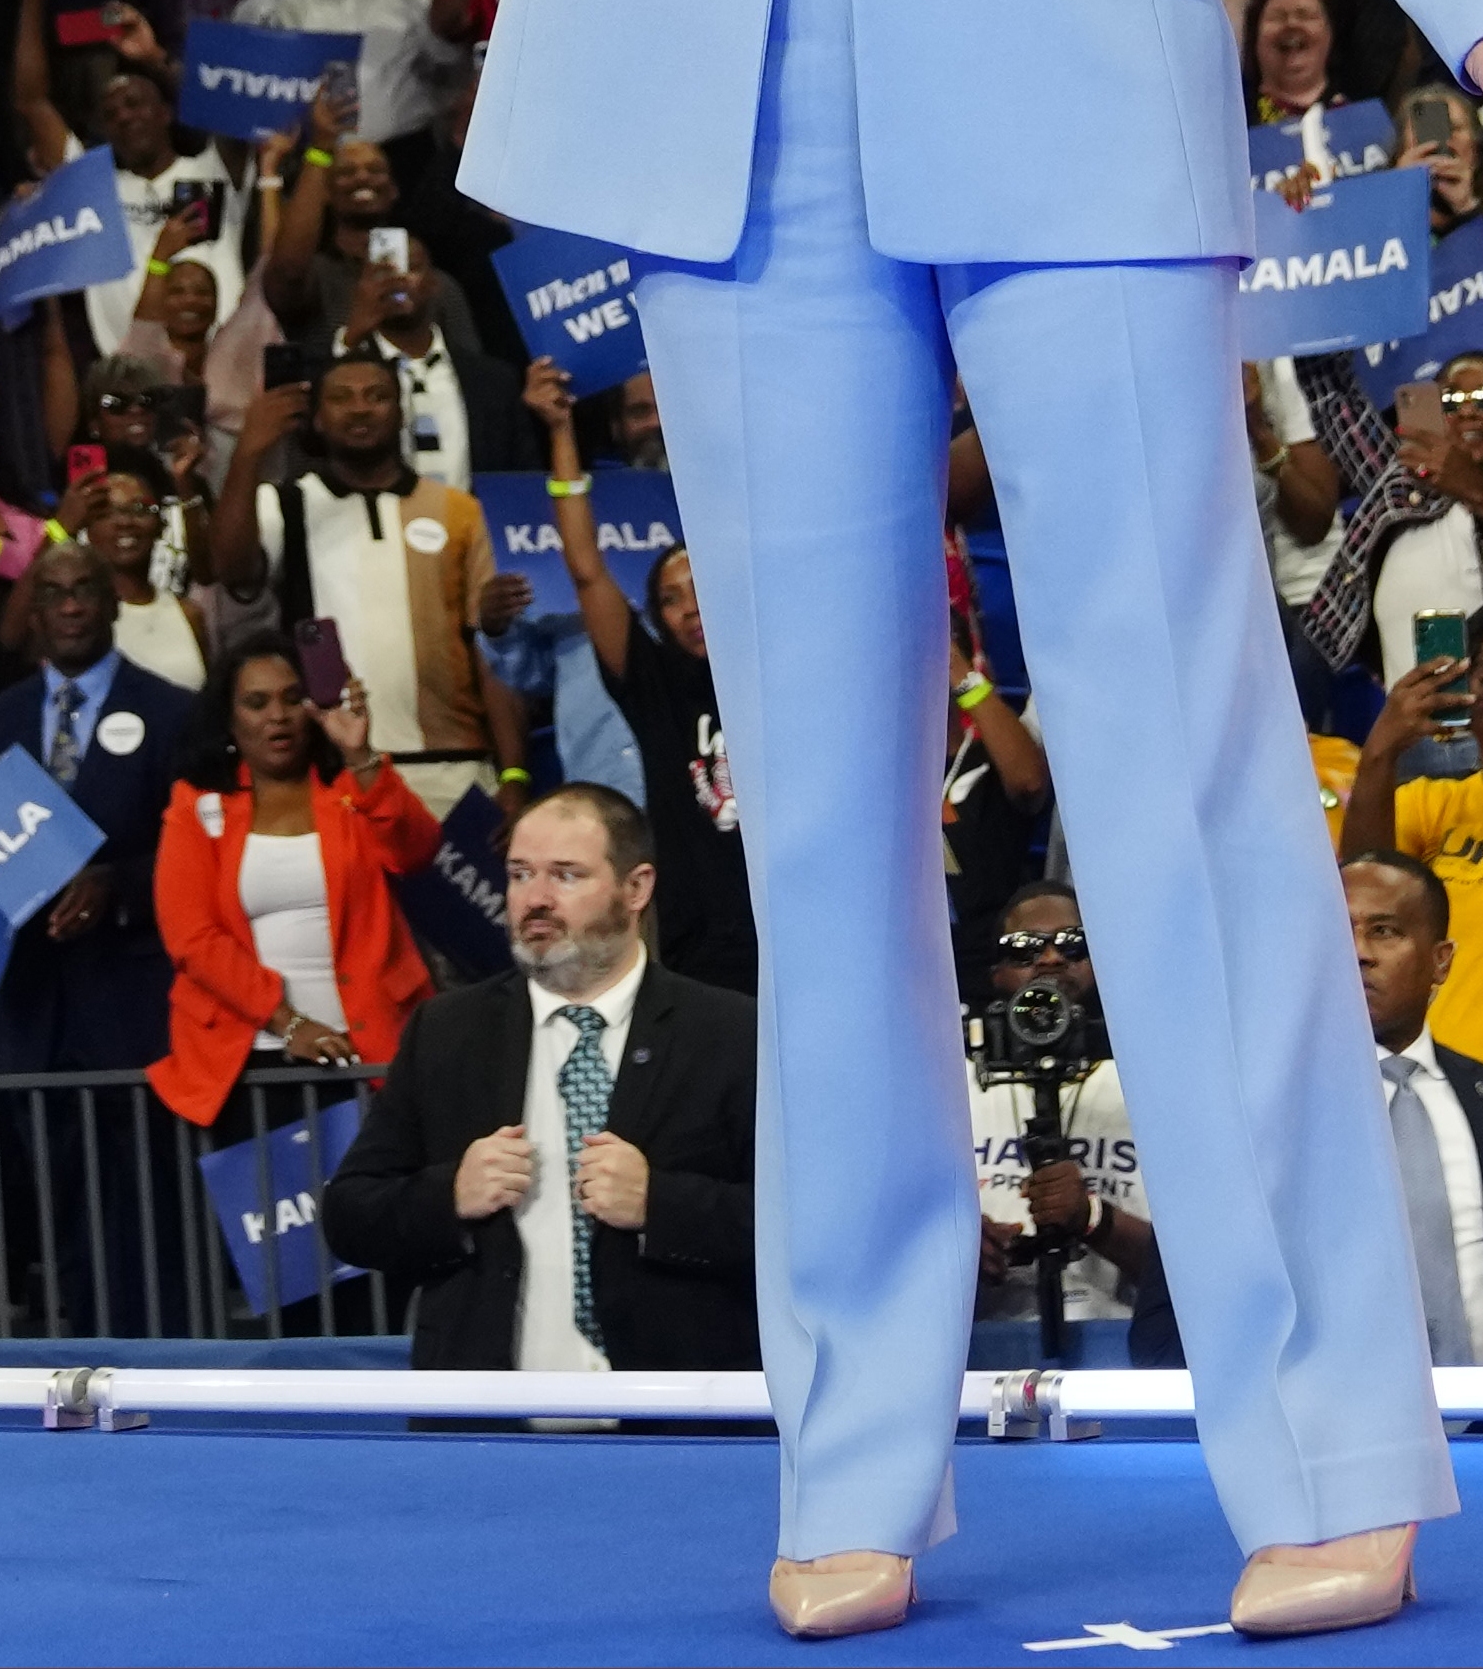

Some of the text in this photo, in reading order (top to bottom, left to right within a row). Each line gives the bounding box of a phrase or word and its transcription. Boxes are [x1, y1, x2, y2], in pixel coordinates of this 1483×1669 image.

[198, 63, 332, 101] AMALA
[1239, 237, 1409, 293] AMALA
[563, 298, 631, 343] WE
[504, 521, 675, 554] KAALA
[974, 1136, 1138, 1173] HARIS
